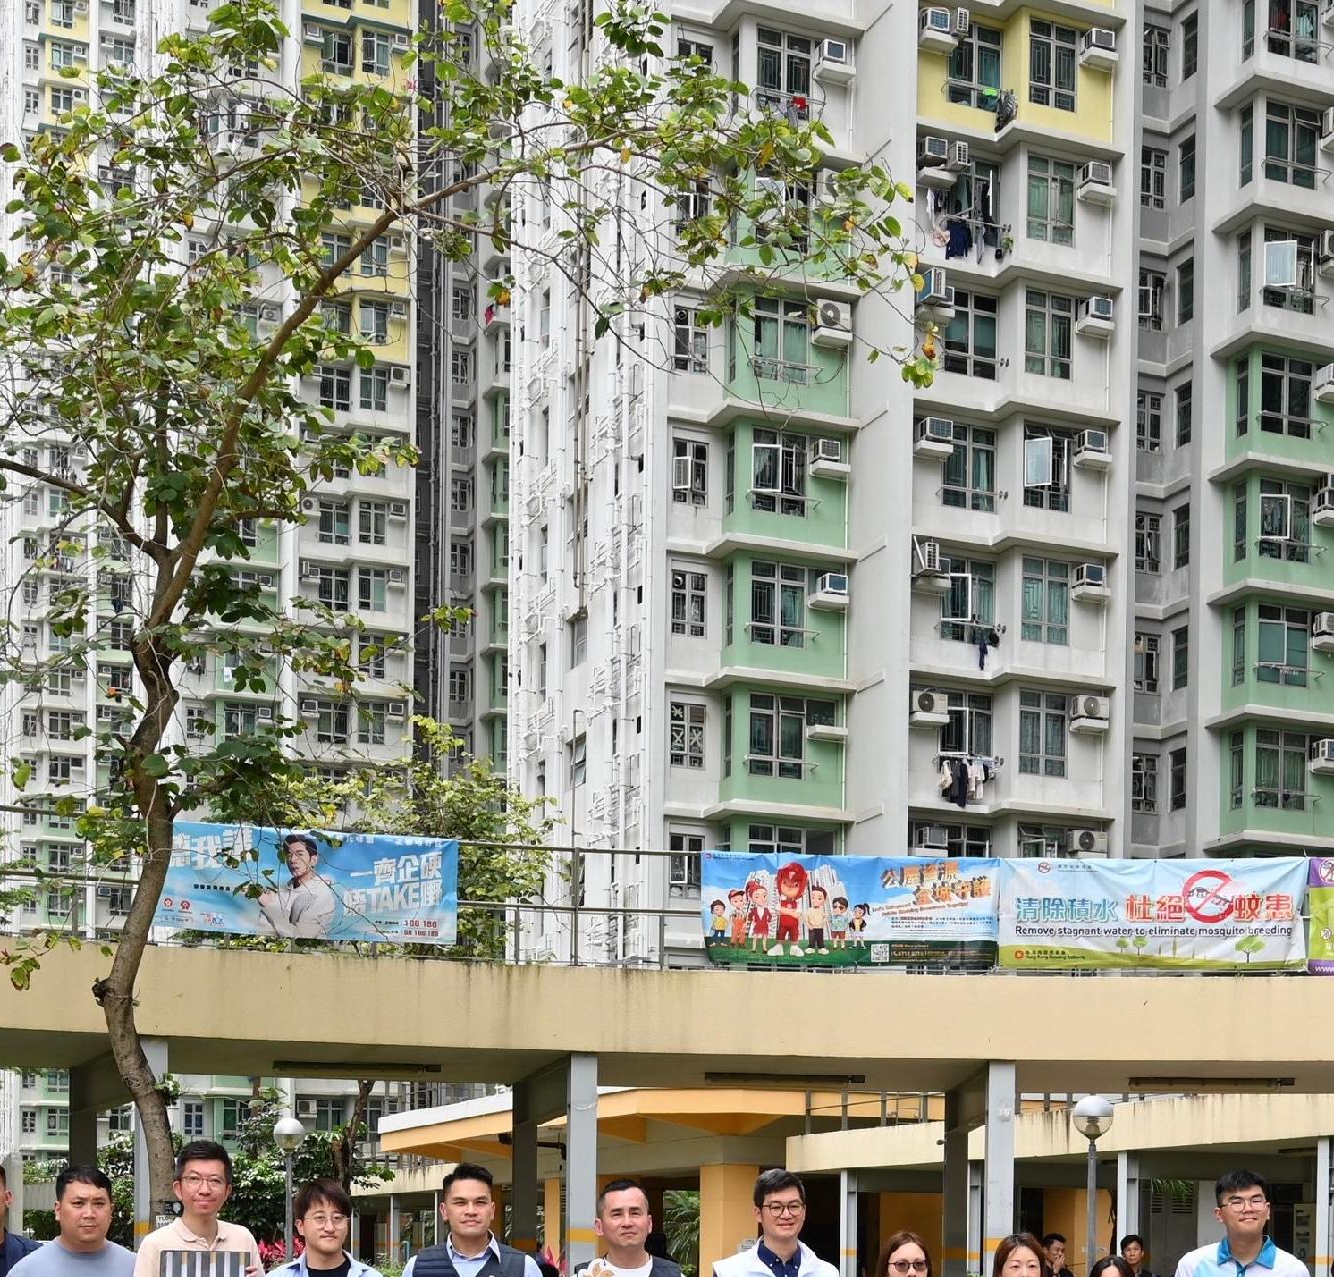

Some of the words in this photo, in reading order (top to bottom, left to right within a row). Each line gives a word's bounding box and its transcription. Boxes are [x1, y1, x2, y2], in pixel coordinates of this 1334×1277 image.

[350, 851, 443, 886] 一齊企硬
[1016, 897, 1118, 923] 清除積水
[1125, 895, 1186, 923] 杜絕
[1234, 894, 1295, 923] 蚊患
[1015, 925, 1054, 937] Remove
[1057, 926, 1101, 938] stagnant
[1102, 926, 1132, 937] water
[1135, 925, 1146, 937] to
[1148, 925, 1196, 937] eliminate
[1199, 926, 1245, 938] mosquito
